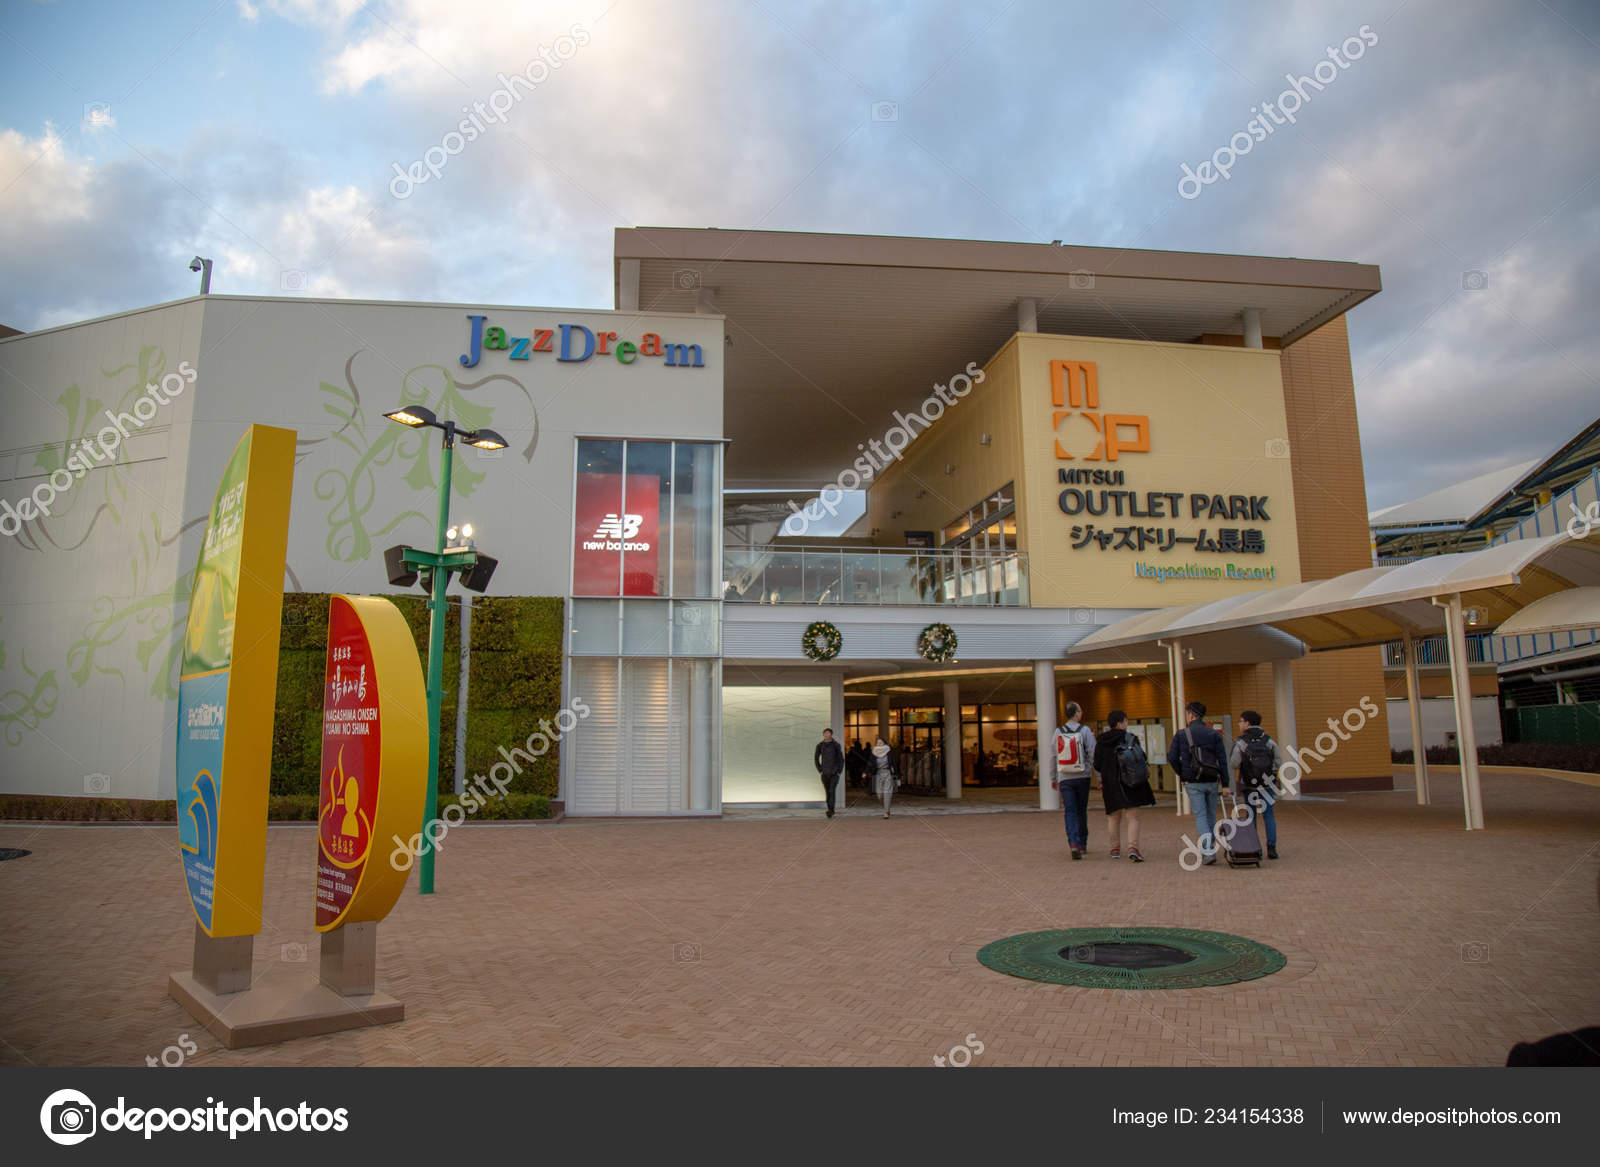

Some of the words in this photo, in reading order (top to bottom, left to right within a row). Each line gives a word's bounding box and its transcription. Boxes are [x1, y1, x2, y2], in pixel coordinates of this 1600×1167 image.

[1058, 468, 1124, 486] MITSUI
[1059, 488, 1184, 518] OUTLET
[1191, 494, 1271, 521] PARK
[593, 513, 643, 539] NB
[583, 541, 605, 551] new
[606, 540, 650, 551] baance
[1070, 525, 1265, 554] ジャズドリーム長島
[1226, 563, 1275, 580] Resort
[357, 707, 378, 721] ONSEN
[343, 722, 351, 735] NO
[352, 722, 369, 735] SHIMA
